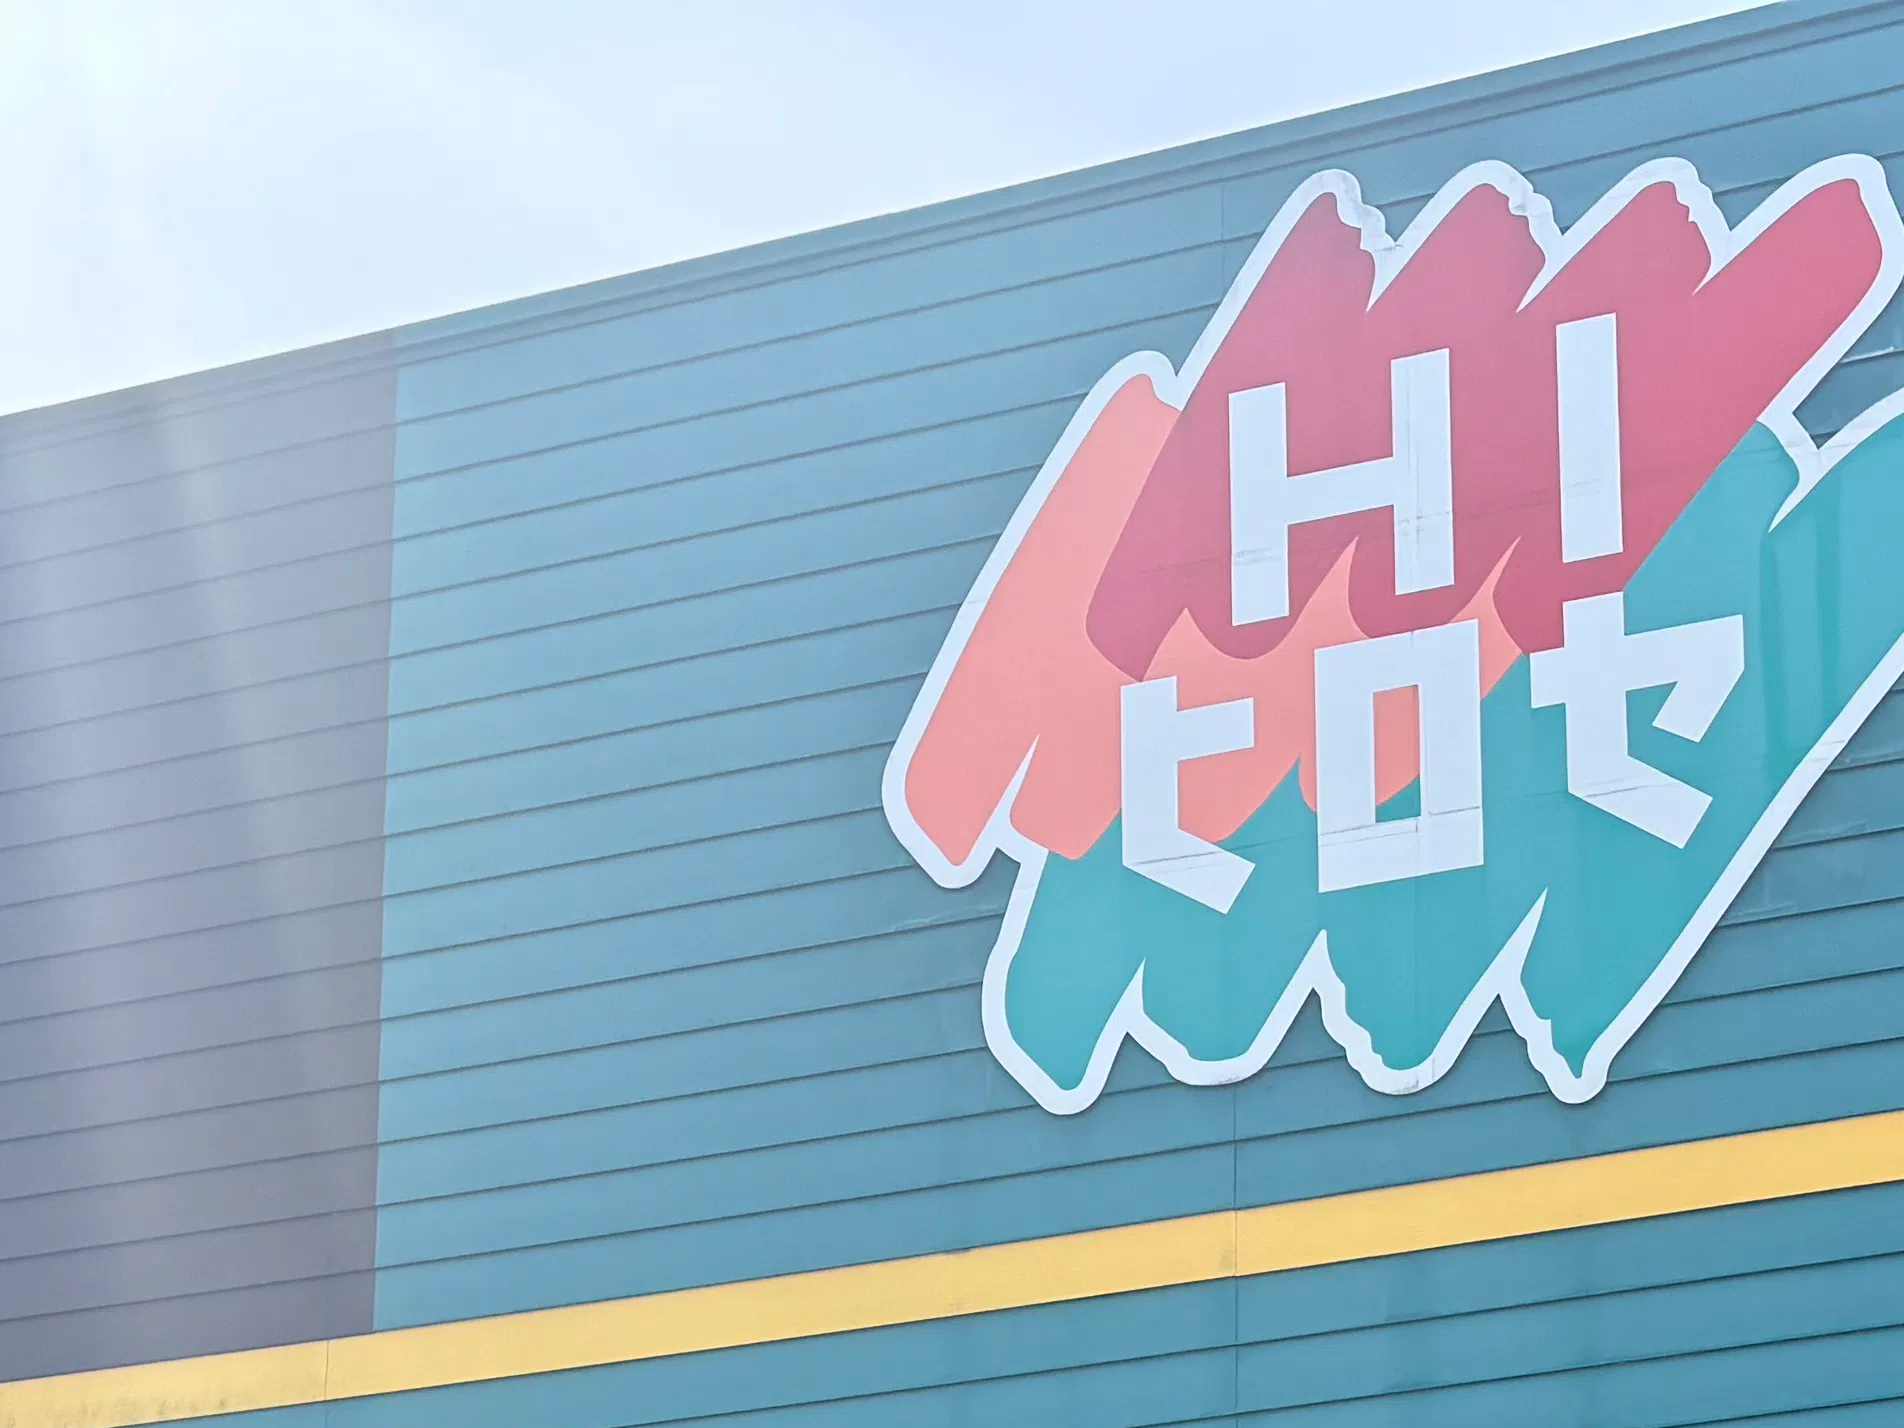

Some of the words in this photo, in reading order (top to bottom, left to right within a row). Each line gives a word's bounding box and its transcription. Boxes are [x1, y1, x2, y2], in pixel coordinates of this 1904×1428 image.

[1229, 311, 1625, 626] HI
[1120, 591, 1745, 915] ヒロセ
